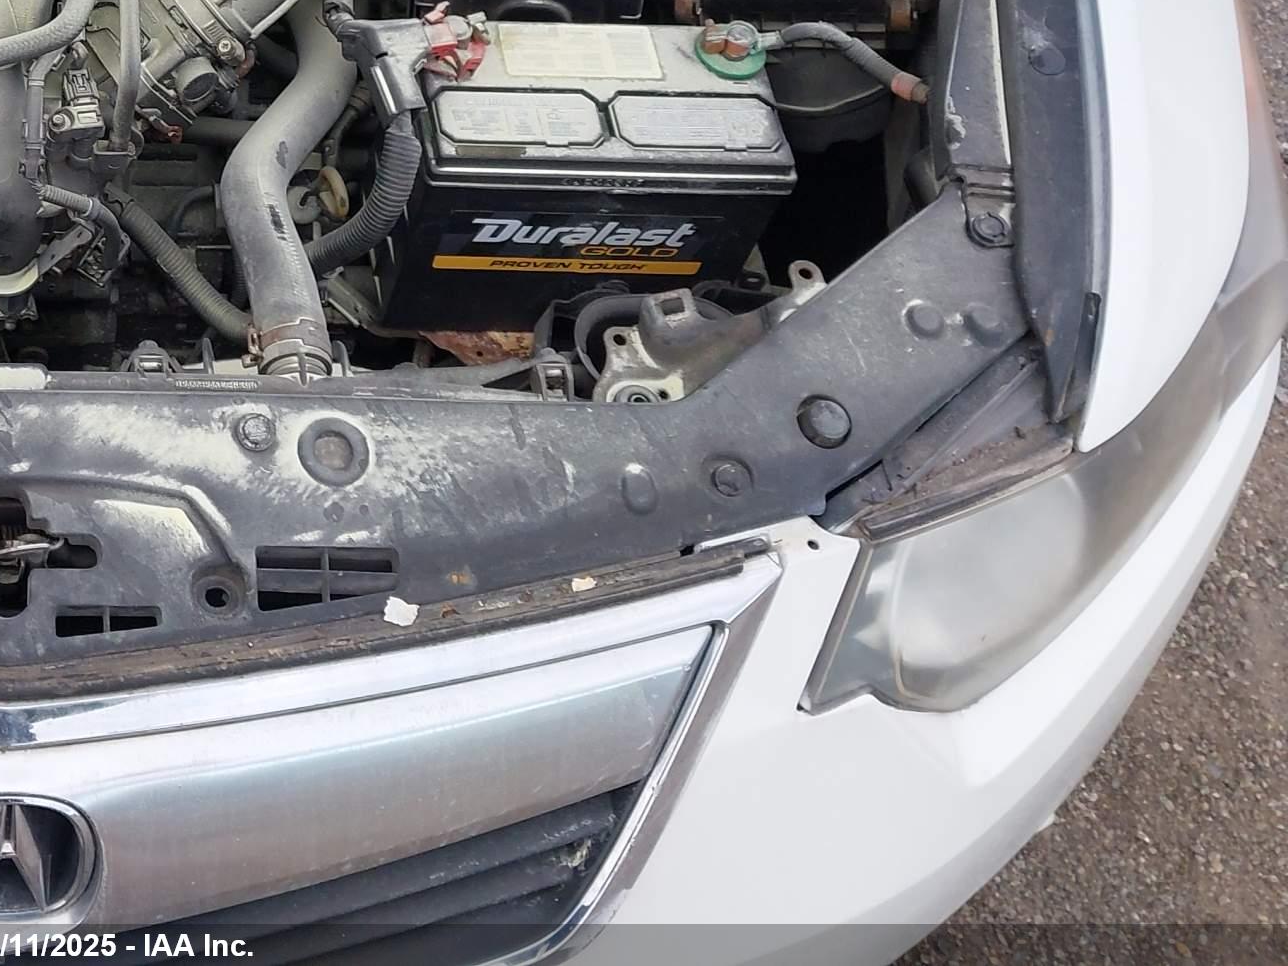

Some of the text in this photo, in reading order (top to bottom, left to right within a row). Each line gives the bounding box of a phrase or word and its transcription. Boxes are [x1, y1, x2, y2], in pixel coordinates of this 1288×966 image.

[472, 218, 697, 247] Duralast
[580, 246, 679, 258] GOLD
[489, 260, 647, 271] PROVEN TOUGH
